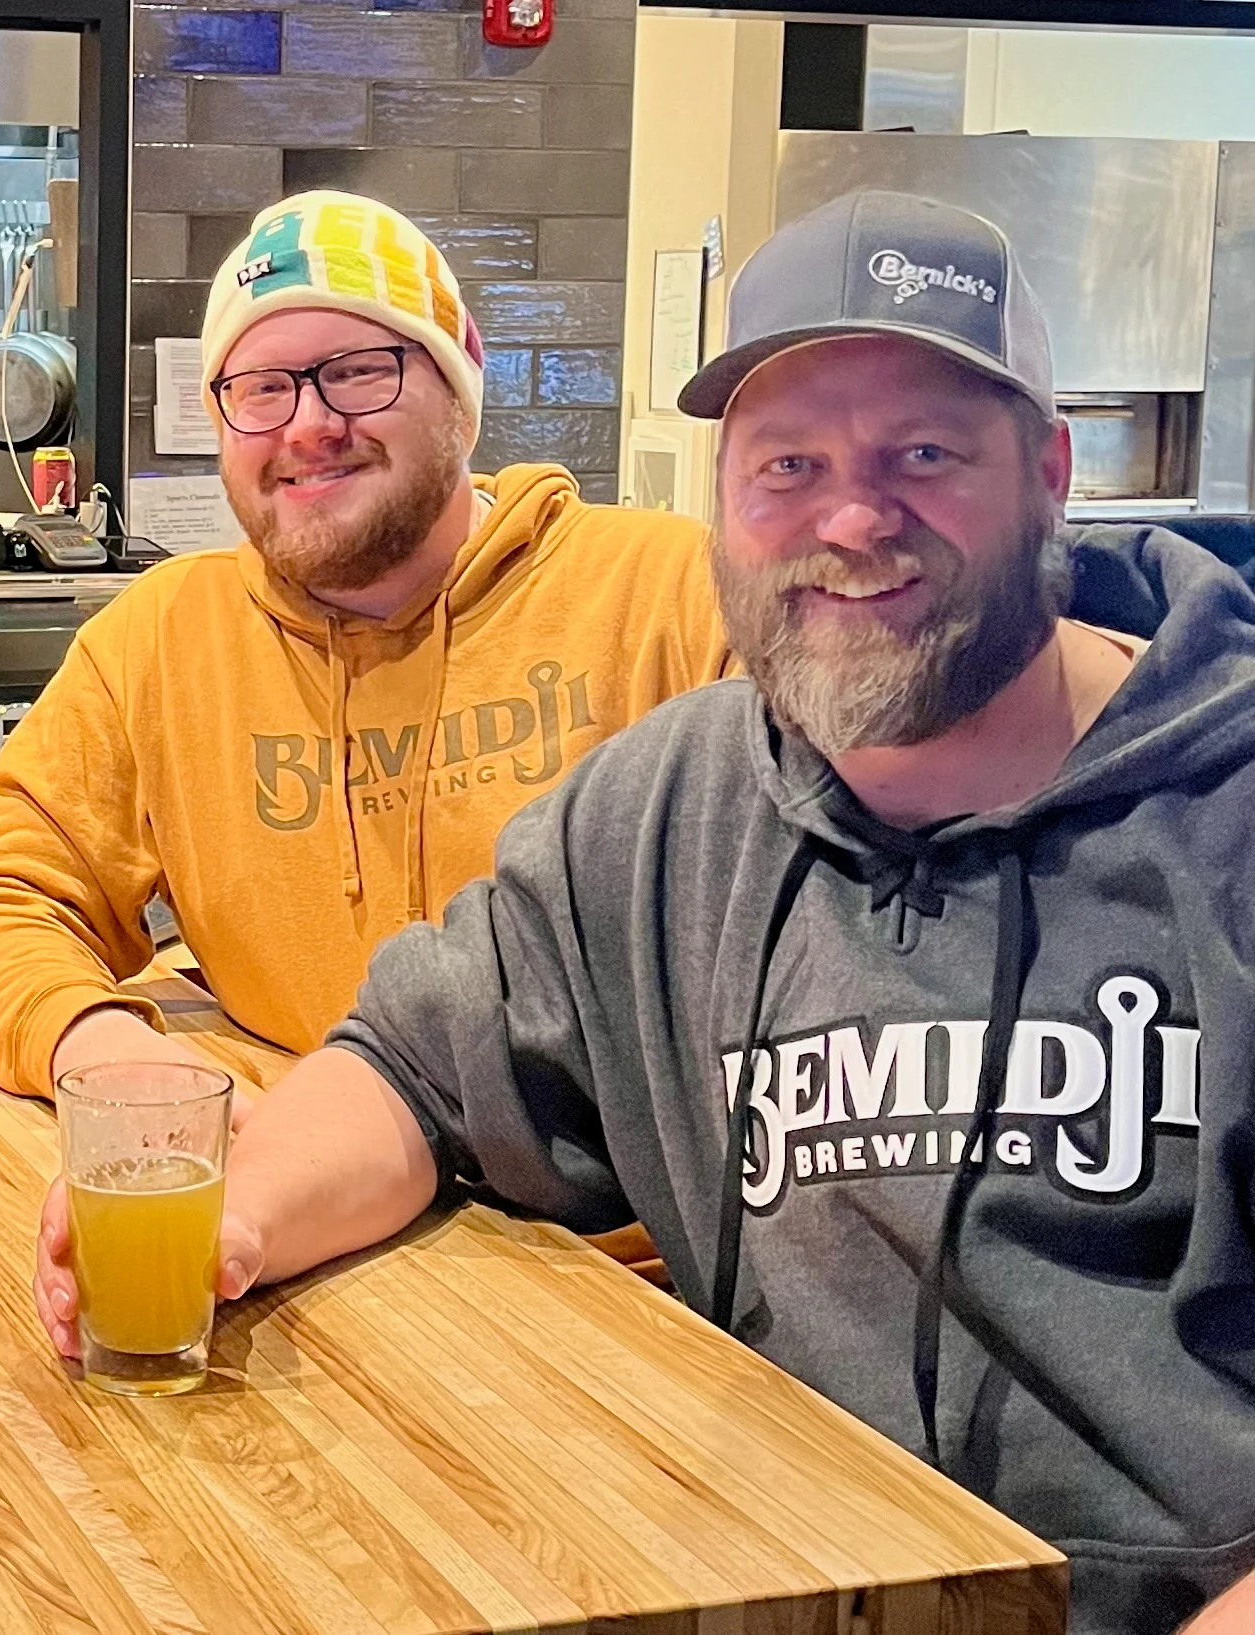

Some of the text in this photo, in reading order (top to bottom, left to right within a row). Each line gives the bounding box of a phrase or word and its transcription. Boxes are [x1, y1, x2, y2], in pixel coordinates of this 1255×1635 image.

[872, 250, 997, 304] Bernick's
[721, 976, 1200, 1207] BEMIDJI
[794, 1130, 1033, 1178] BREWING
